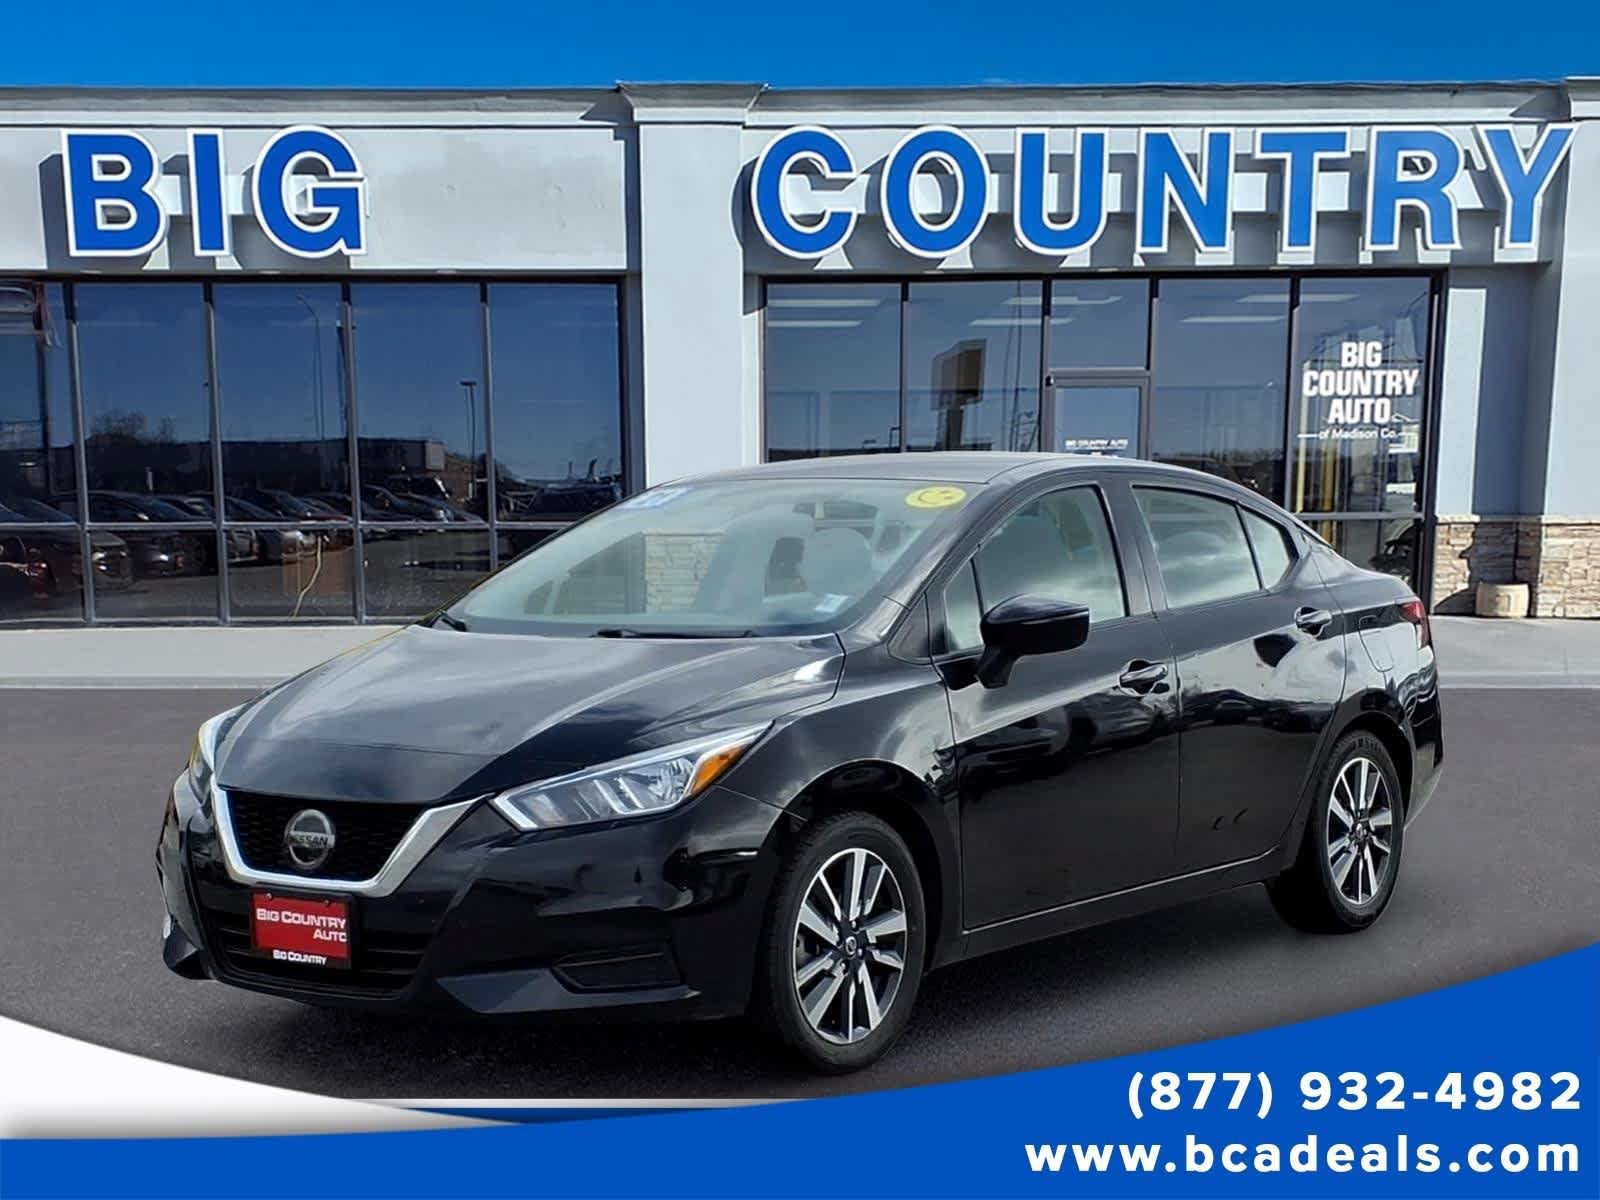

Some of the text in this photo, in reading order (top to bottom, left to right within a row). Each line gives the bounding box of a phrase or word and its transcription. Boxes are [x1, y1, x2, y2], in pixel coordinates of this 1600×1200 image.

[62, 124, 1577, 259] BIG COUNTRY
[1341, 341, 1383, 368] BIG
[1303, 369, 1419, 397] COUNTRY
[1328, 398, 1391, 424] AUTO
[1319, 428, 1329, 440] of
[1331, 428, 1377, 439] Madison
[289, 831, 329, 849] NISSAN
[256, 908, 346, 929] BIG COUNTRY
[313, 929, 347, 943] AUTO
[288, 951, 327, 965] COUNTRY
